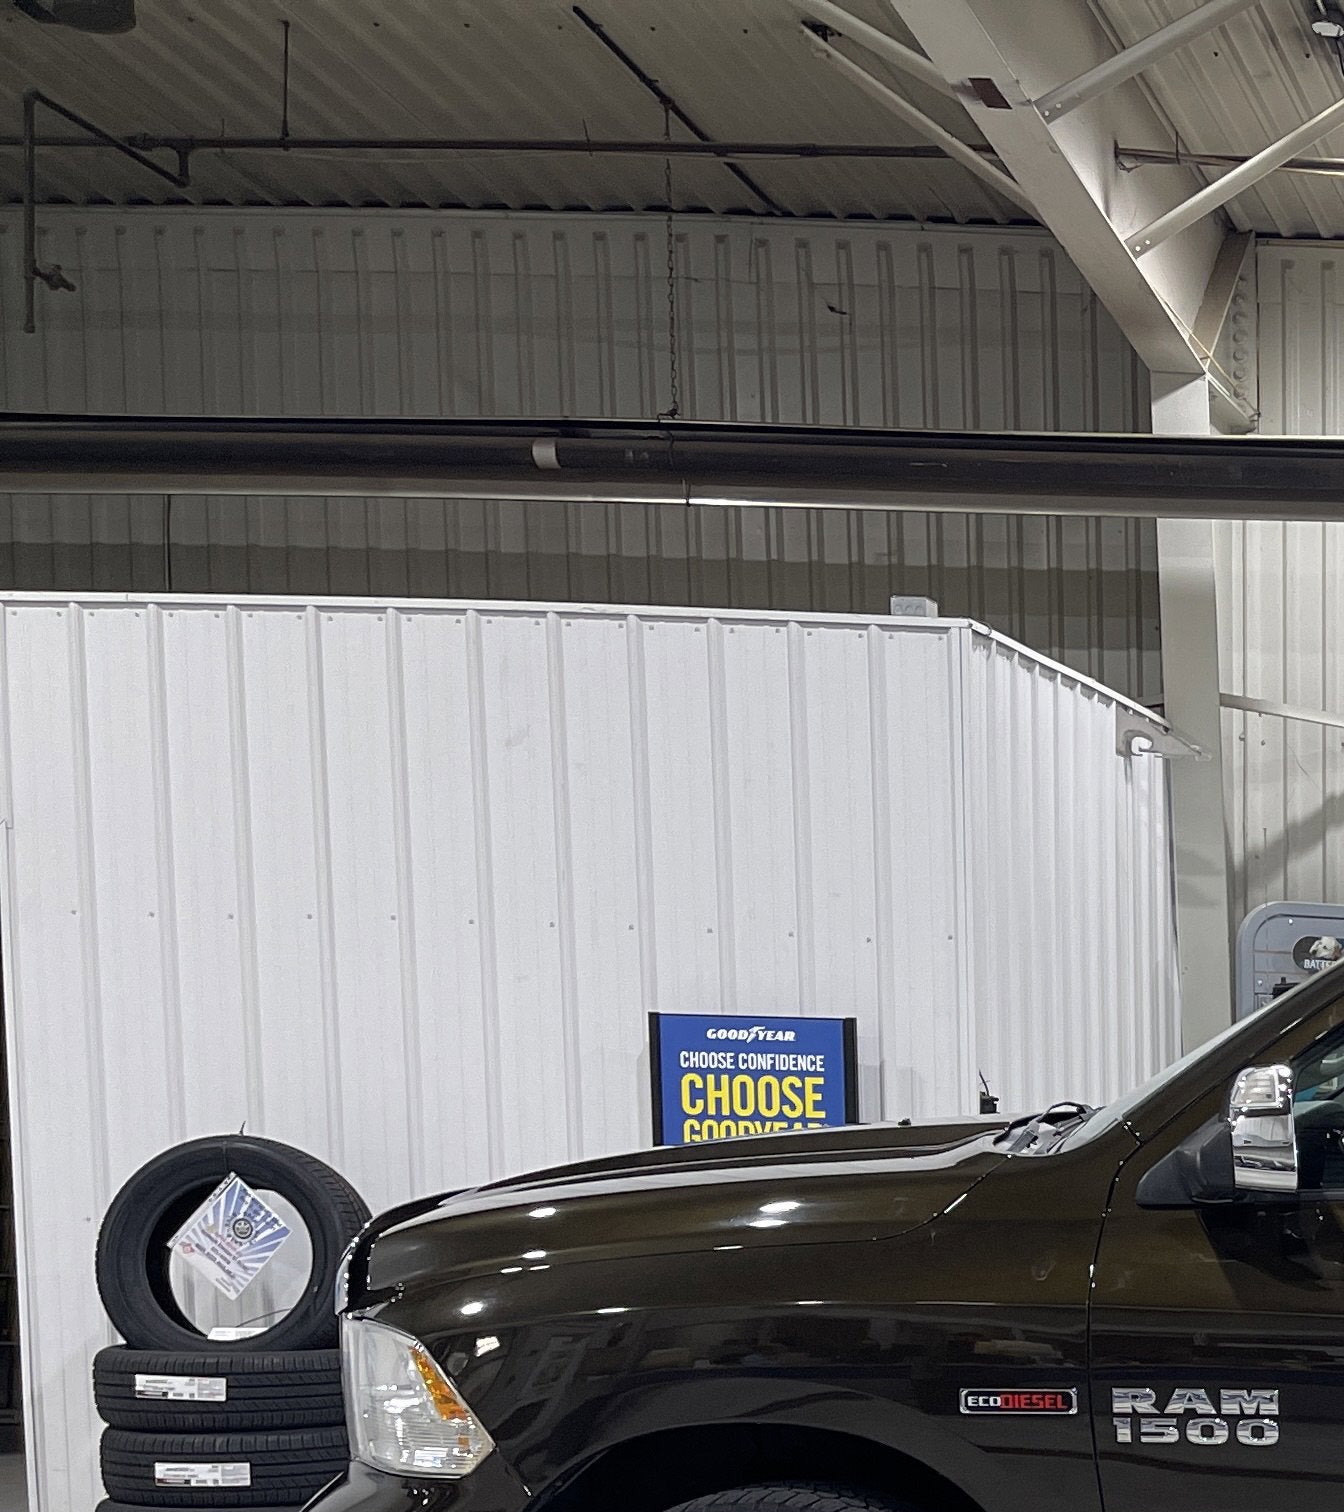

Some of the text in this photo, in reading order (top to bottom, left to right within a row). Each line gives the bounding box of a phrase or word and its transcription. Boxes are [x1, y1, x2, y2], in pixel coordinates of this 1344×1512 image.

[706, 1025, 797, 1044] GOODYEAR
[679, 1050, 825, 1072] CHOOSE CONFIDENCE
[680, 1072, 826, 1119] CHOOSE
[967, 1393, 1069, 1409] ECODIESEL
[1112, 1387, 1280, 1415] RAM
[1112, 1417, 1280, 1446] 1500
